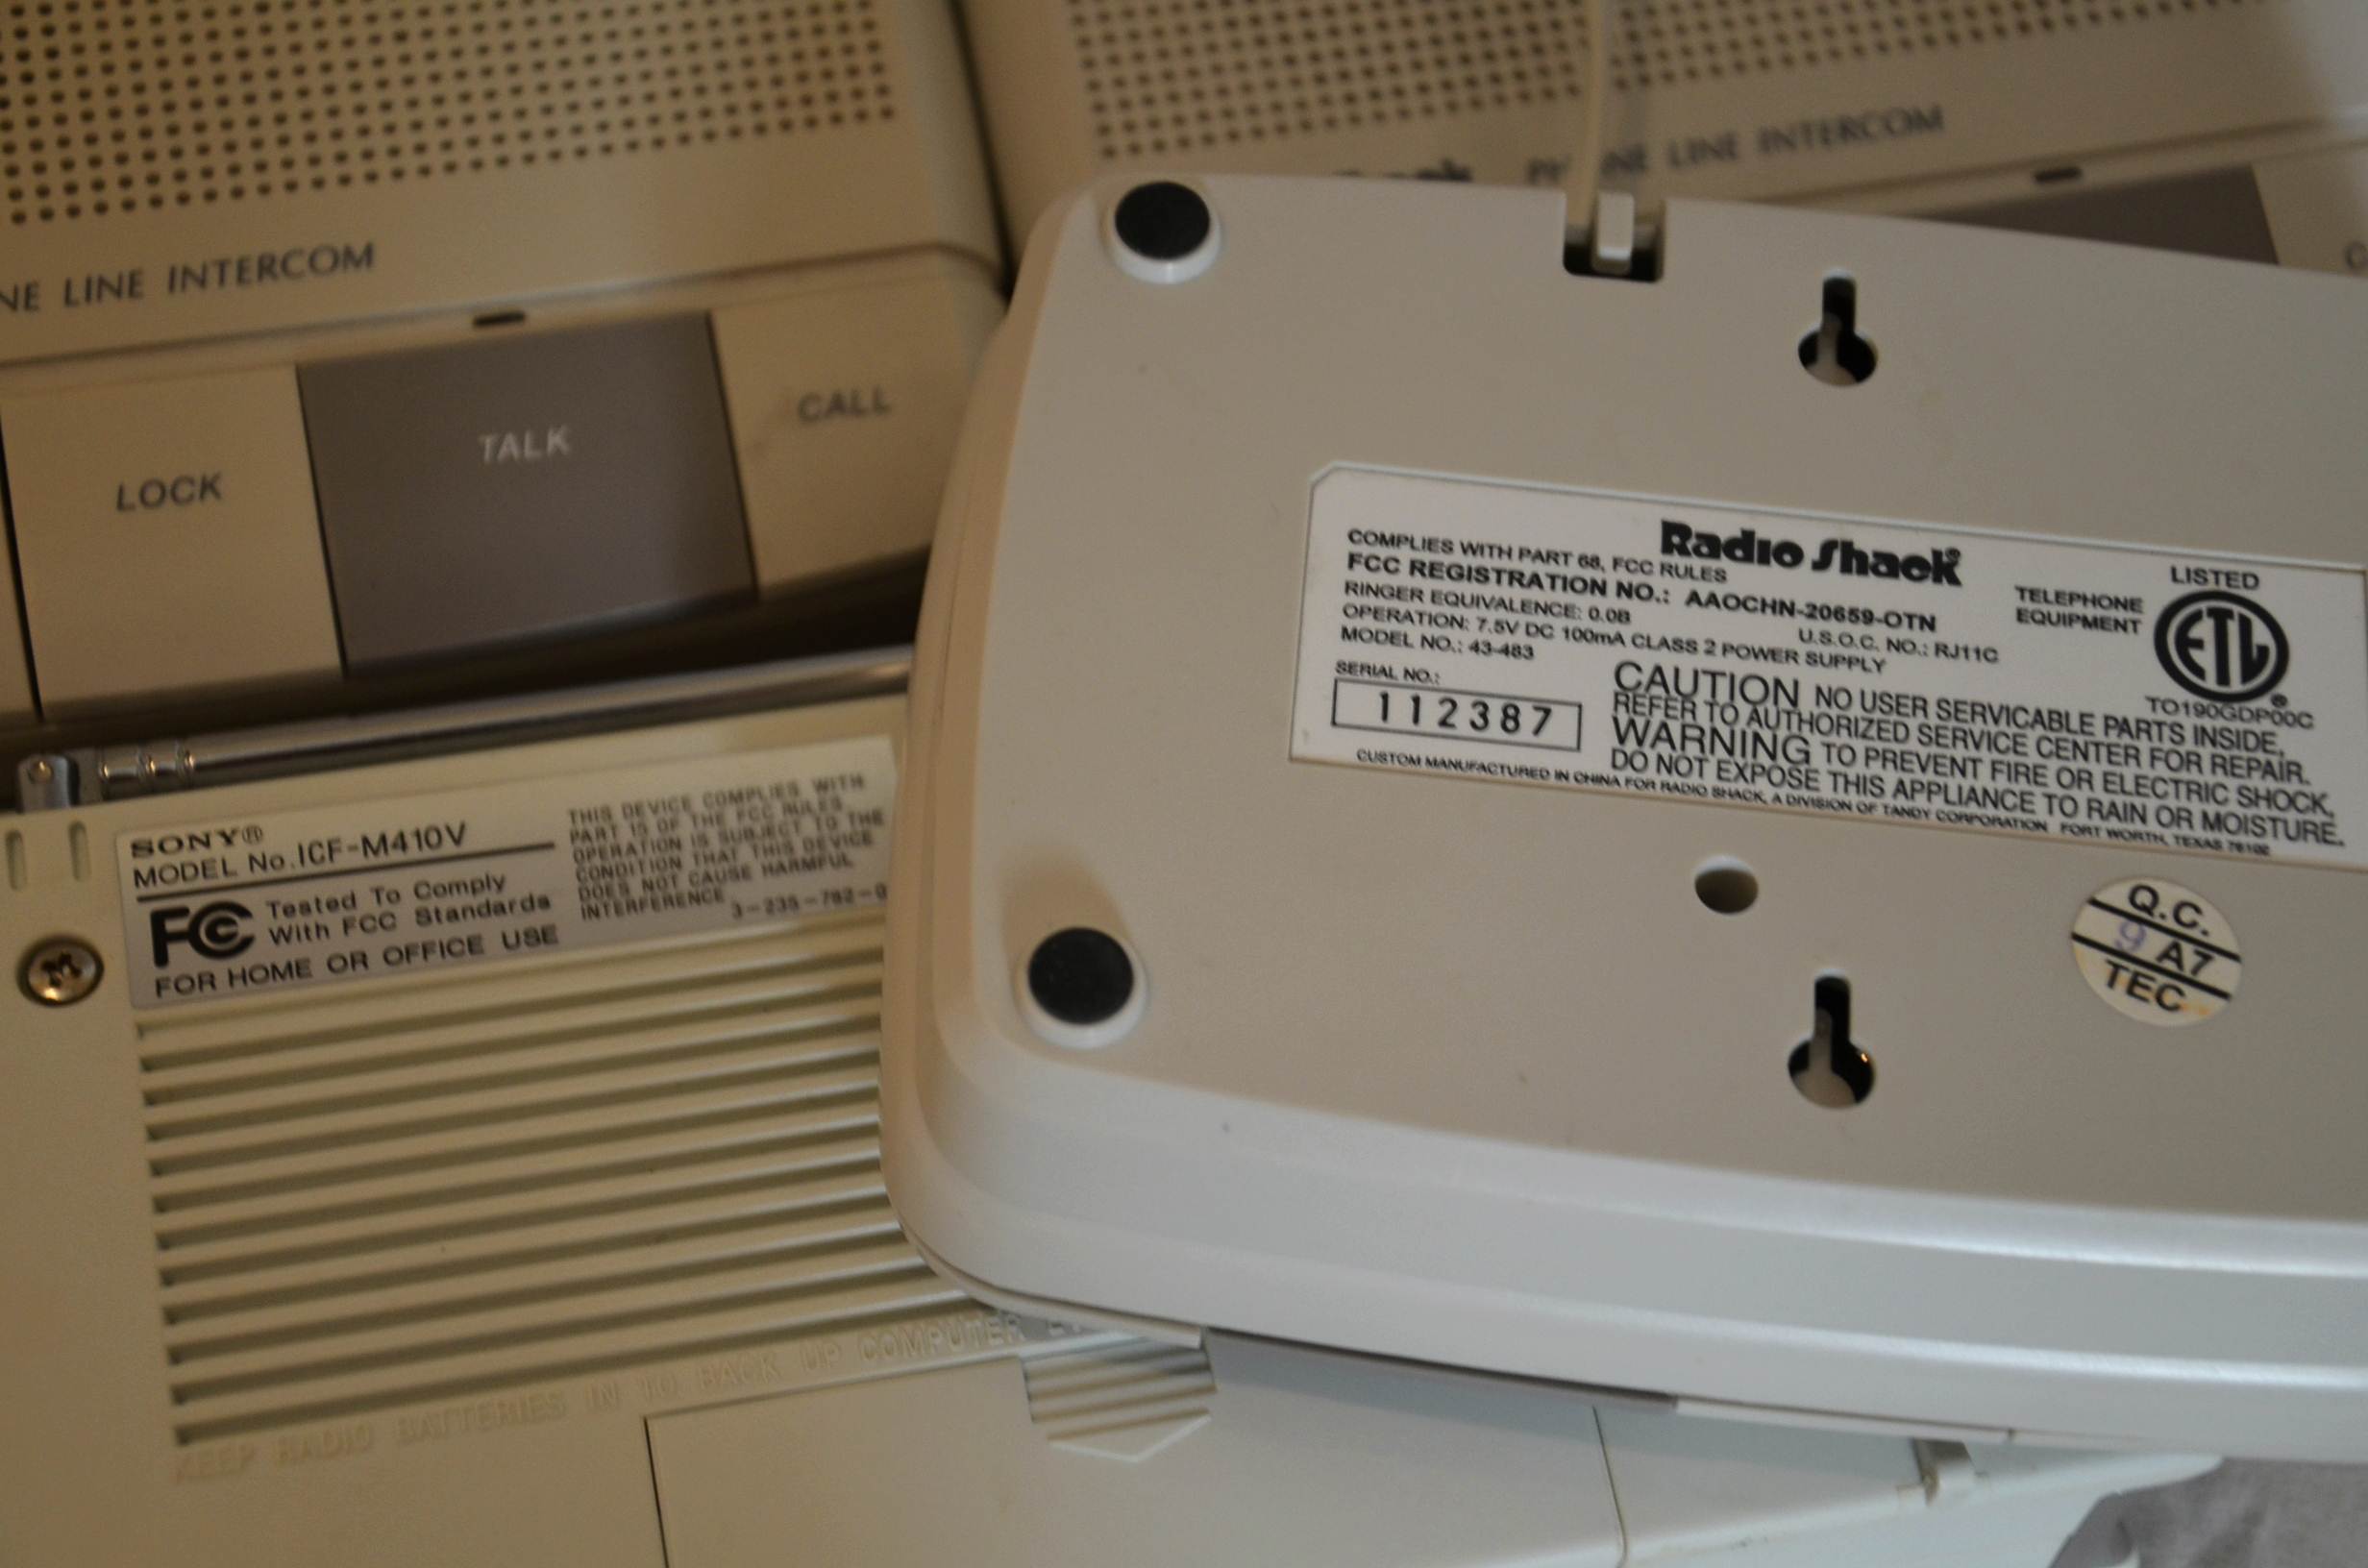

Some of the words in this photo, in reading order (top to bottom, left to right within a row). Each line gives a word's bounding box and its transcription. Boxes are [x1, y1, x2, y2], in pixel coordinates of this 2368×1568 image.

[1666, 133, 1739, 170] LINE
[1757, 104, 1945, 160] INTERCOM
[62, 268, 144, 307] LINE
[167, 240, 376, 295] INTERCOM
[797, 385, 893, 424] CALL
[479, 424, 573, 465] TALK
[115, 471, 225, 514] LOCK
[1347, 528, 1454, 553] COMPLIES
[1460, 540, 1513, 560] WITH
[1517, 548, 1571, 567] PART
[1577, 553, 1606, 573] 68,
[1612, 556, 1655, 576] FCC
[1660, 558, 1727, 583] RULES
[1660, 519, 1805, 569] Radio
[1344, 579, 1424, 603] RINGER
[1430, 588, 1583, 620] EQUIVALENCE:
[1346, 551, 1401, 575] FCC
[1408, 558, 1608, 598] REGISTRATION
[1616, 580, 1670, 604] NO.:
[2015, 585, 2144, 613] TELEPHONE
[2171, 565, 2260, 591] LISTED
[1340, 625, 1414, 649] MODEL
[1420, 633, 1463, 654] NO.:
[1343, 602, 1469, 631] OPERATION:
[1476, 617, 1519, 635] 7.5V
[1525, 624, 1554, 640] DC
[1563, 626, 1625, 648] 100mA
[1631, 633, 1699, 655] CLASS
[1704, 639, 1716, 655] 2
[1721, 642, 1800, 665] POWER
[1805, 649, 1888, 674] SUPPLY
[1798, 627, 1880, 651] U.S.O.C.
[1887, 636, 1928, 657] NO.:
[1934, 642, 2000, 665] RJ11C
[2015, 607, 2143, 635] EQUIPMENT
[2174, 605, 2271, 688] ETL
[1335, 659, 1400, 680] SERIAL
[1403, 666, 1441, 686] NO.:
[1379, 690, 1553, 737] 112387
[1614, 661, 1801, 708] CAUTION
[1814, 685, 1854, 711] NO
[1860, 689, 1929, 720] USER
[1935, 698, 2096, 737] SERVICABLE
[2103, 714, 2185, 746] PARTS
[2193, 724, 2285, 757] INSIDE,
[1612, 691, 1698, 722] REFER
[1705, 701, 1739, 726] TO
[1746, 706, 1911, 745] AUTHORIZED
[1916, 723, 2028, 756] SERVICE
[2035, 734, 2141, 769] CENTER
[2149, 747, 2204, 774] FOR
[2210, 755, 2311, 786] REPAIR.
[1612, 715, 1813, 766] WARNING
[1821, 741, 1857, 767] TO
[1864, 747, 1984, 780] PREVENT
[1990, 758, 2049, 788] FIRE
[2056, 767, 2095, 794] OR
[2102, 773, 2229, 807] ELECTRIC
[2236, 785, 2335, 818] SHOCK,
[568, 805, 613, 826] THIS
[621, 794, 693, 819] DEVICE
[702, 780, 800, 810] COMPLIES
[811, 773, 865, 795] WITH
[569, 824, 619, 845] PART
[657, 817, 679, 834] OF
[690, 811, 723, 829] THE
[781, 796, 843, 817] RULES
[1356, 747, 1421, 768] CUSTOM
[1425, 756, 1550, 783] MANUFACTURED
[1554, 771, 1569, 783] IN
[1574, 772, 1621, 788] CHINA
[1624, 775, 1657, 791] FOR
[1661, 780, 1708, 797] RADIO
[1772, 794, 1783, 805] A
[1786, 794, 1853, 814] DIVISION
[1856, 800, 1876, 815] OF
[1883, 803, 1929, 821] TANDY
[1935, 809, 2048, 834] CORPORATION
[2060, 821, 2102, 838] FORT
[2172, 834, 2225, 853] TEXAS
[1611, 747, 1650, 773] DO
[1656, 753, 1709, 779] NOT
[1716, 758, 1821, 792] EXPOSE
[1828, 771, 1886, 798] THIS
[1891, 776, 2036, 816] APPLIANCE
[2041, 793, 2080, 819] TO
[2086, 797, 2147, 826] RAIN
[2155, 804, 2194, 830] OR
[2201, 812, 2346, 847] MOISTURE.
[573, 837, 682, 865] OPERATION
[691, 833, 709, 849] IS
[720, 820, 802, 845] SUBJECT
[814, 814, 839, 832] TO
[848, 807, 885, 827] THE
[576, 856, 682, 884] CONDITION
[693, 848, 739, 869] THAT
[752, 839, 795, 861] THIS
[802, 828, 874, 854] DEVICE
[134, 855, 239, 890] MODEL
[266, 893, 358, 920] Tested
[370, 886, 402, 909] To
[413, 873, 506, 903] Comply
[578, 881, 629, 902] DOES
[641, 873, 679, 894] NOT
[688, 866, 752, 889] CAUSE
[761, 852, 853, 878] HARMFUL
[267, 919, 331, 947] With
[342, 912, 397, 941] FCC
[580, 888, 725, 921] INTERFERENCE
[2127, 883, 2209, 937] Q.C.
[155, 968, 218, 999] FOR
[227, 956, 314, 991] HOME
[326, 950, 370, 975] OR
[382, 937, 484, 968] OFFICE
[502, 923, 560, 949] USE
[2156, 940, 2215, 976] A7
[2105, 959, 2187, 1013] TEC
[386, 1389, 568, 1445] BATTERIES
[583, 1382, 620, 1411] IN
[698, 1353, 779, 1388] BACK
[800, 1342, 842, 1372] UP
[862, 1312, 1026, 1361] COMPUTER
